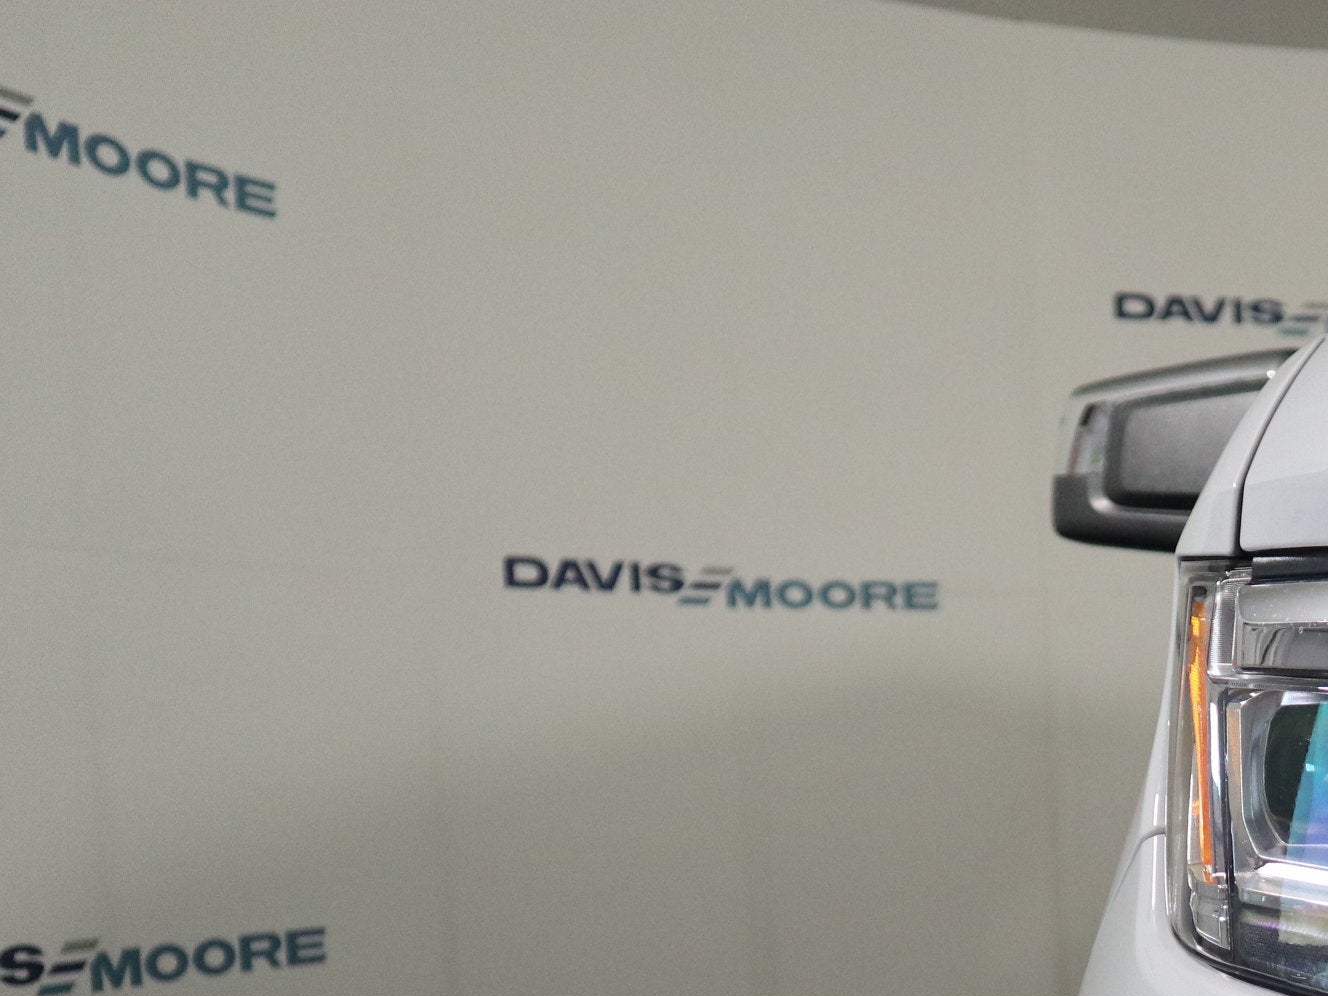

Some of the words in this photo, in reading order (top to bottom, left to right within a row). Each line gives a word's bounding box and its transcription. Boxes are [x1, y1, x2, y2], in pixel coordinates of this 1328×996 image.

[24, 111, 277, 219] MOORE
[1113, 291, 1284, 325] DAVIS
[502, 554, 685, 594] DAVIS
[725, 577, 939, 611] MOORE
[90, 926, 327, 994] MOORE
